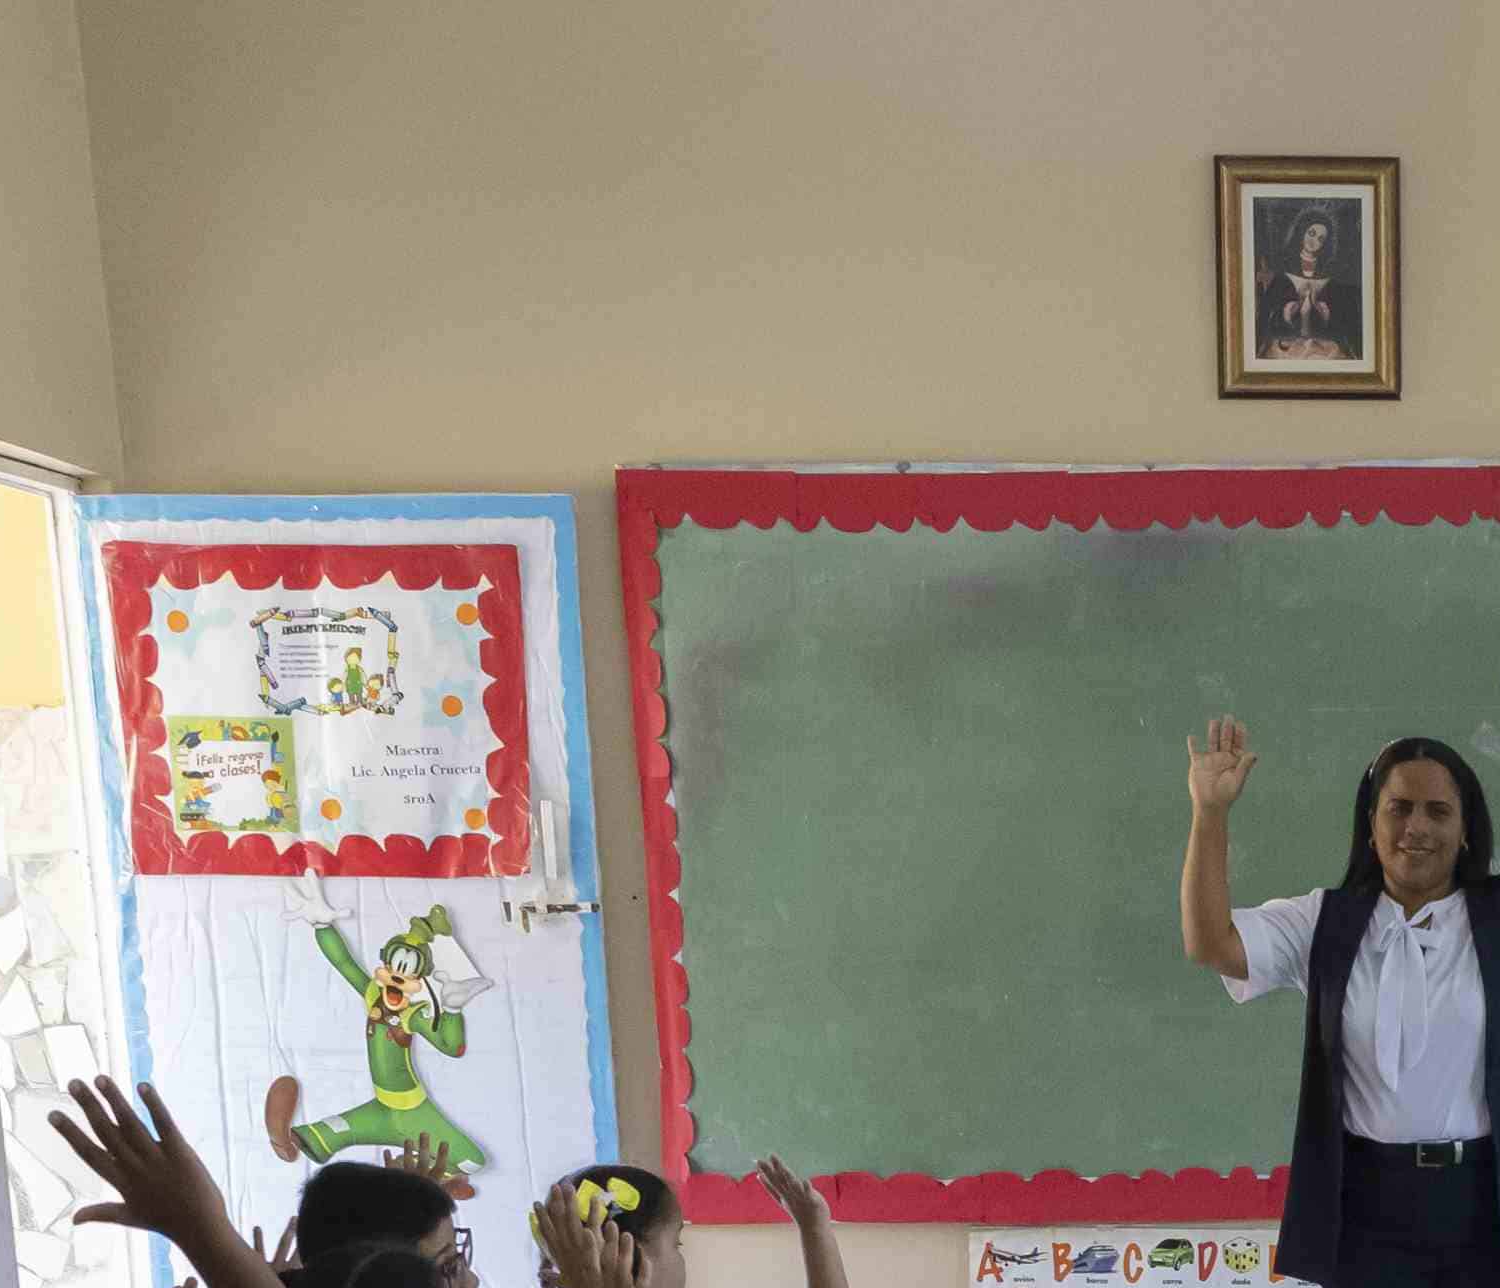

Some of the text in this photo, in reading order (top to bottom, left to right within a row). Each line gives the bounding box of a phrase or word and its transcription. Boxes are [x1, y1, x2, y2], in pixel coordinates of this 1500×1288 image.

[386, 744, 443, 756] Maestra:
[351, 763, 481, 780] Lic. Angela Cruceta
[977, 1242, 1004, 1282] A
[1052, 1243, 1074, 1282] B
[1124, 1242, 1143, 1283] C
[1198, 1241, 1218, 1281] D
